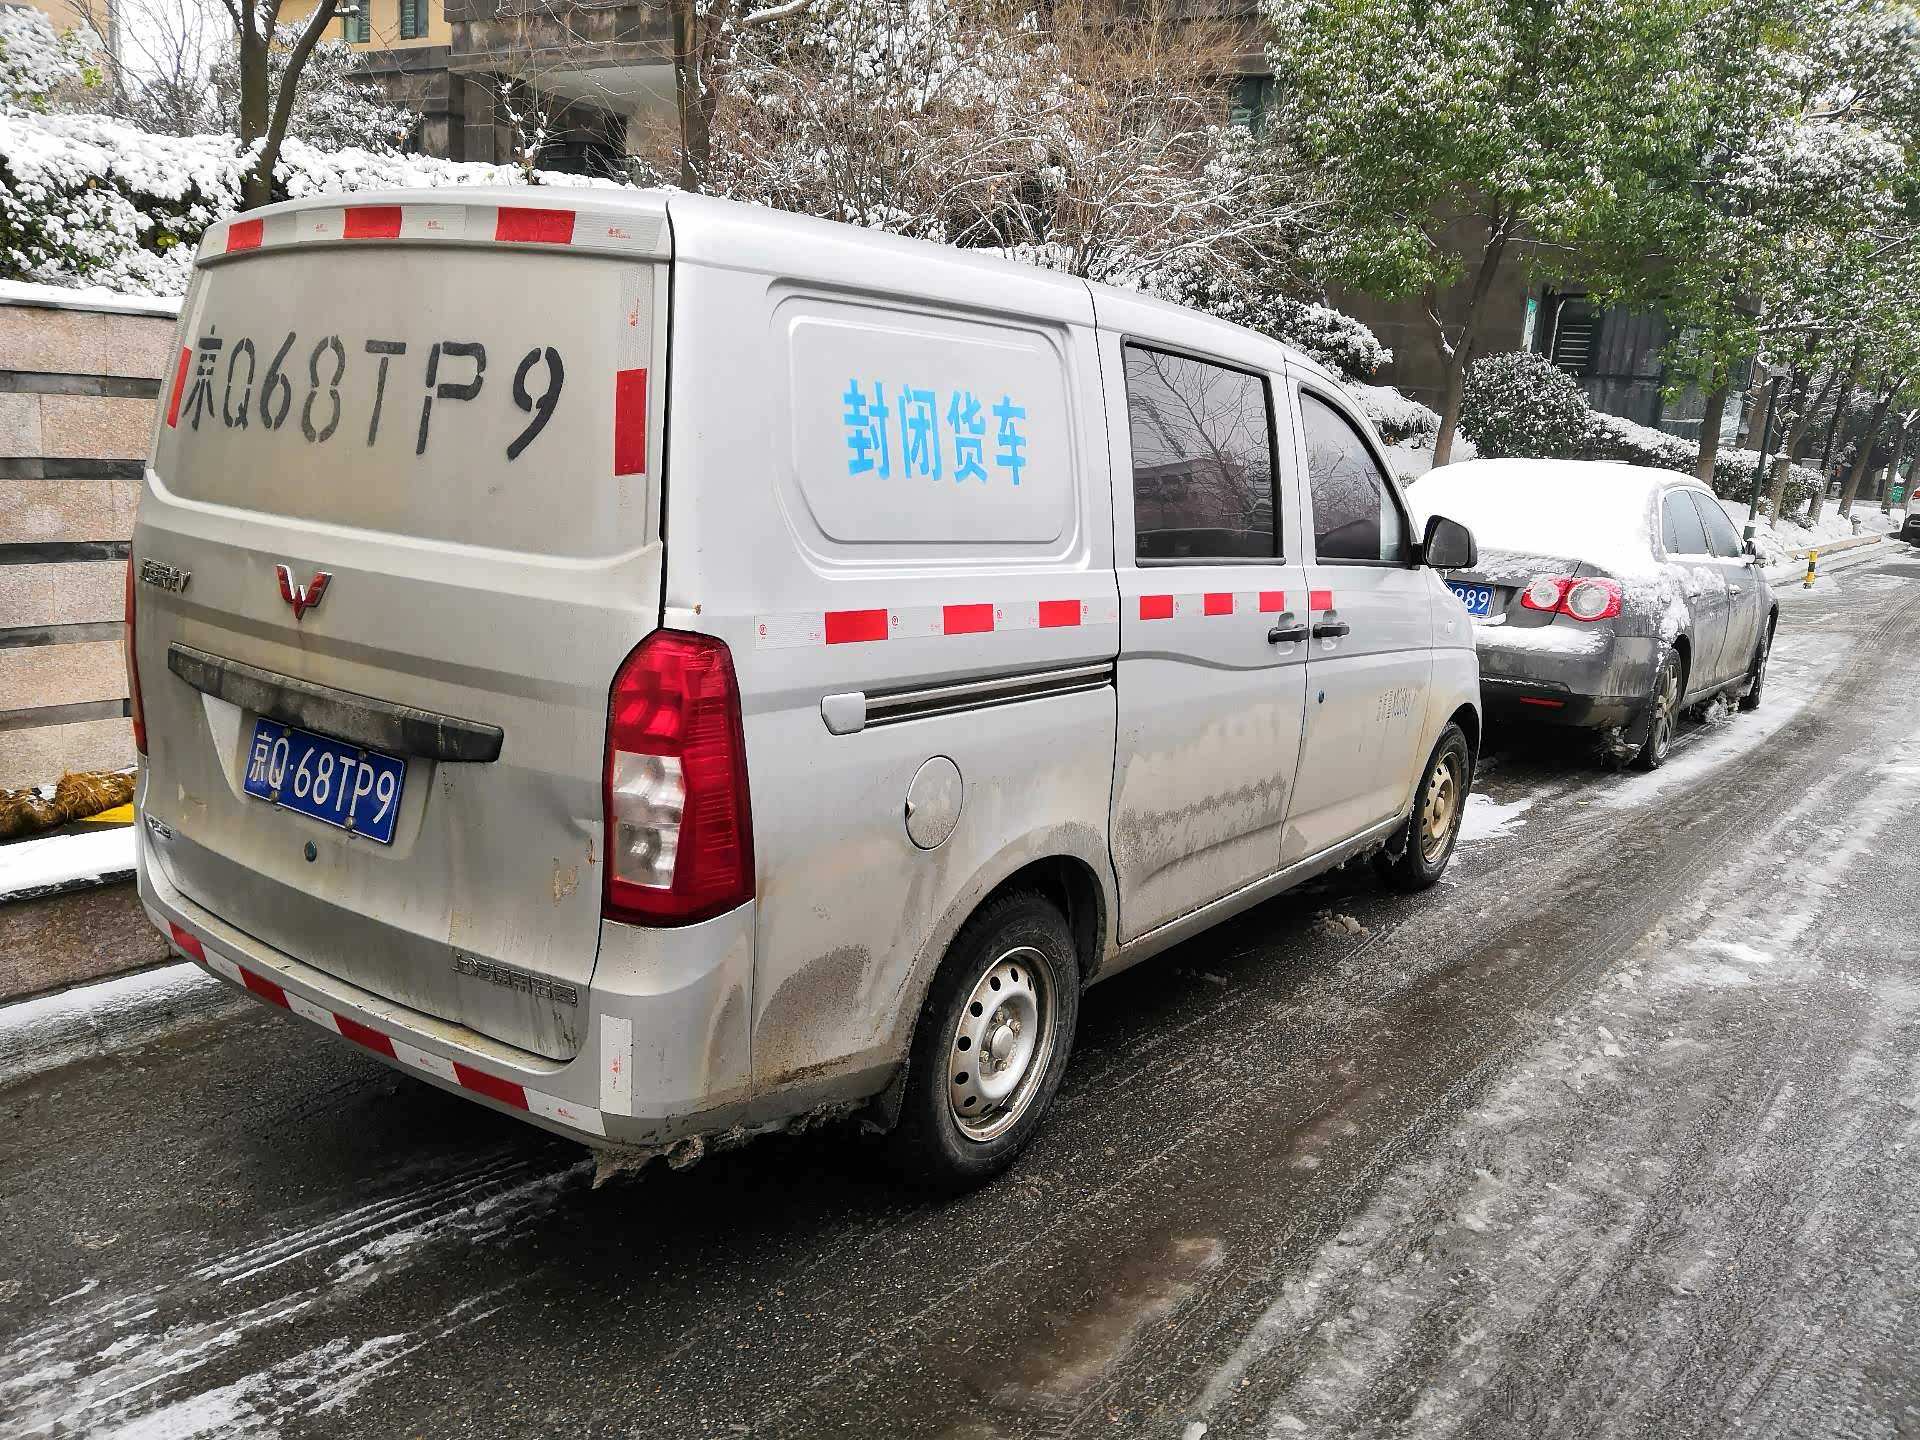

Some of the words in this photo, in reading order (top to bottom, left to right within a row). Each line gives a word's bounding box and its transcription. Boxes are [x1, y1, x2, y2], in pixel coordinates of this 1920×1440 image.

[182, 324, 565, 462] 京Q68TP9
[843, 378, 1027, 486] 封闭货车
